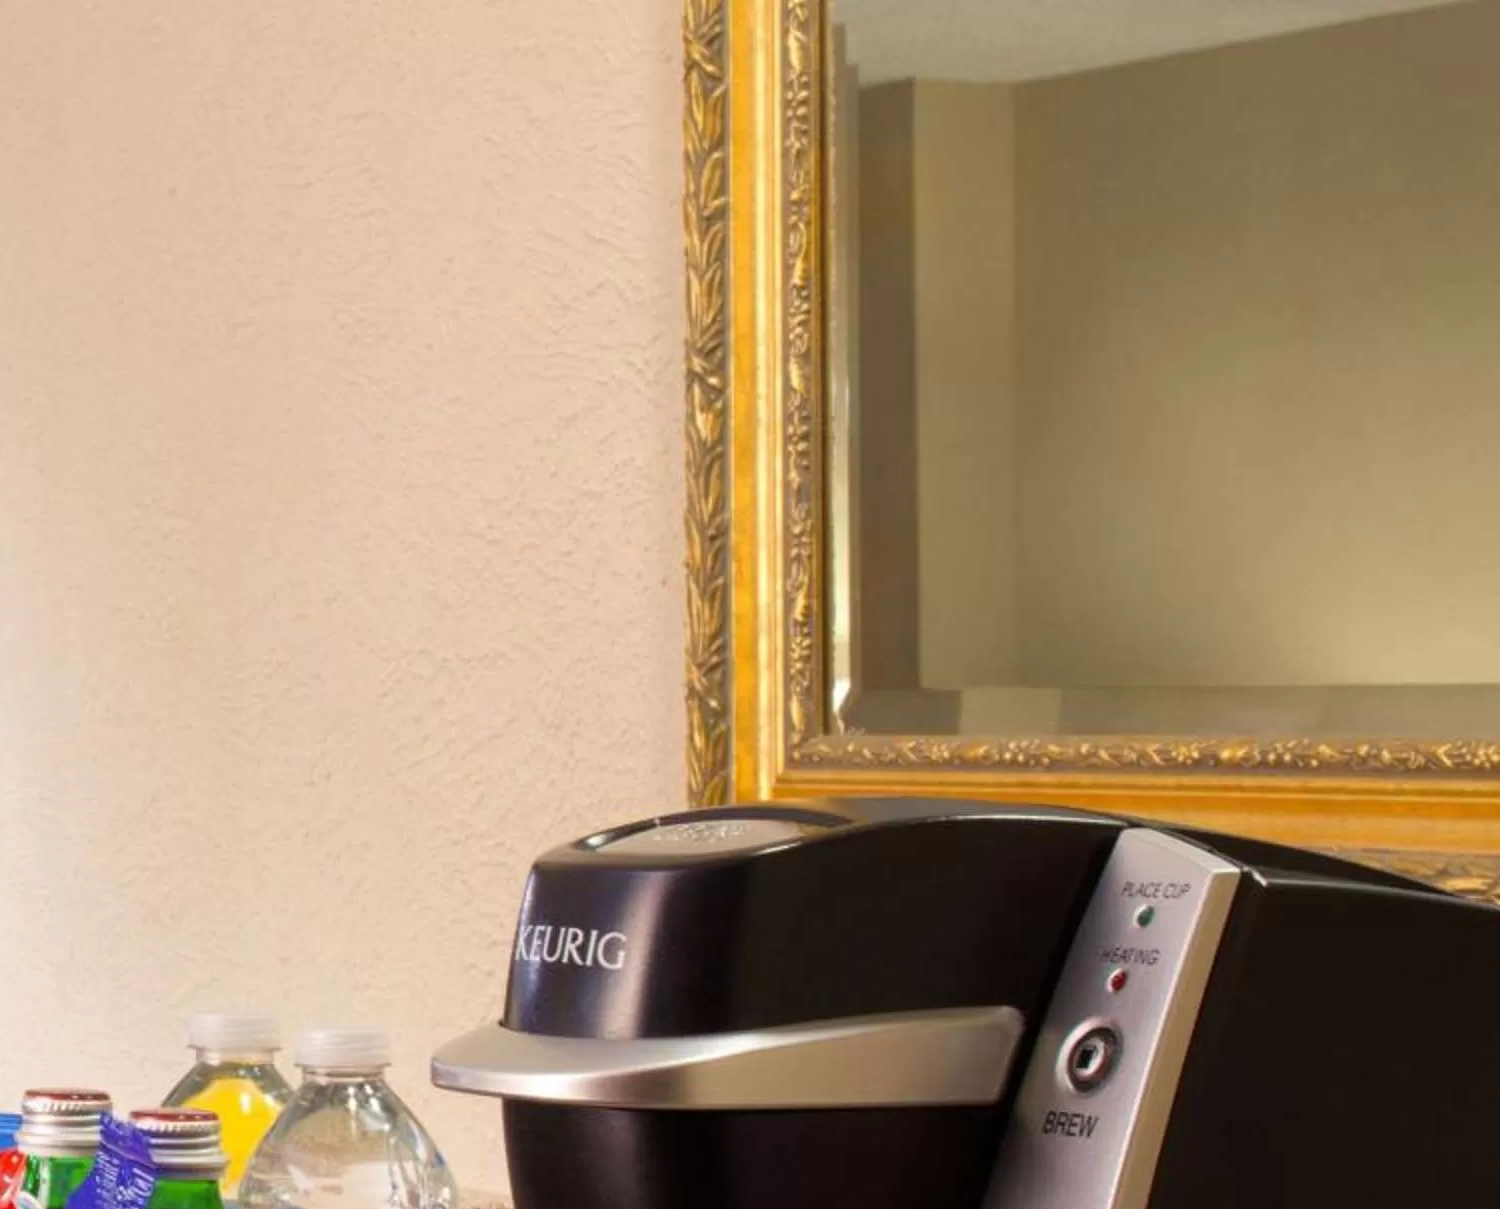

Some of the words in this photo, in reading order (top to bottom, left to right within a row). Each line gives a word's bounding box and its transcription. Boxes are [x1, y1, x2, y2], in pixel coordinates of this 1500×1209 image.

[1121, 881, 1163, 899] PLACE
[1163, 882, 1191, 899] CUP
[515, 924, 627, 970] KEURIG
[1101, 946, 1160, 966] HEATING
[1042, 1109, 1100, 1138] BREW
